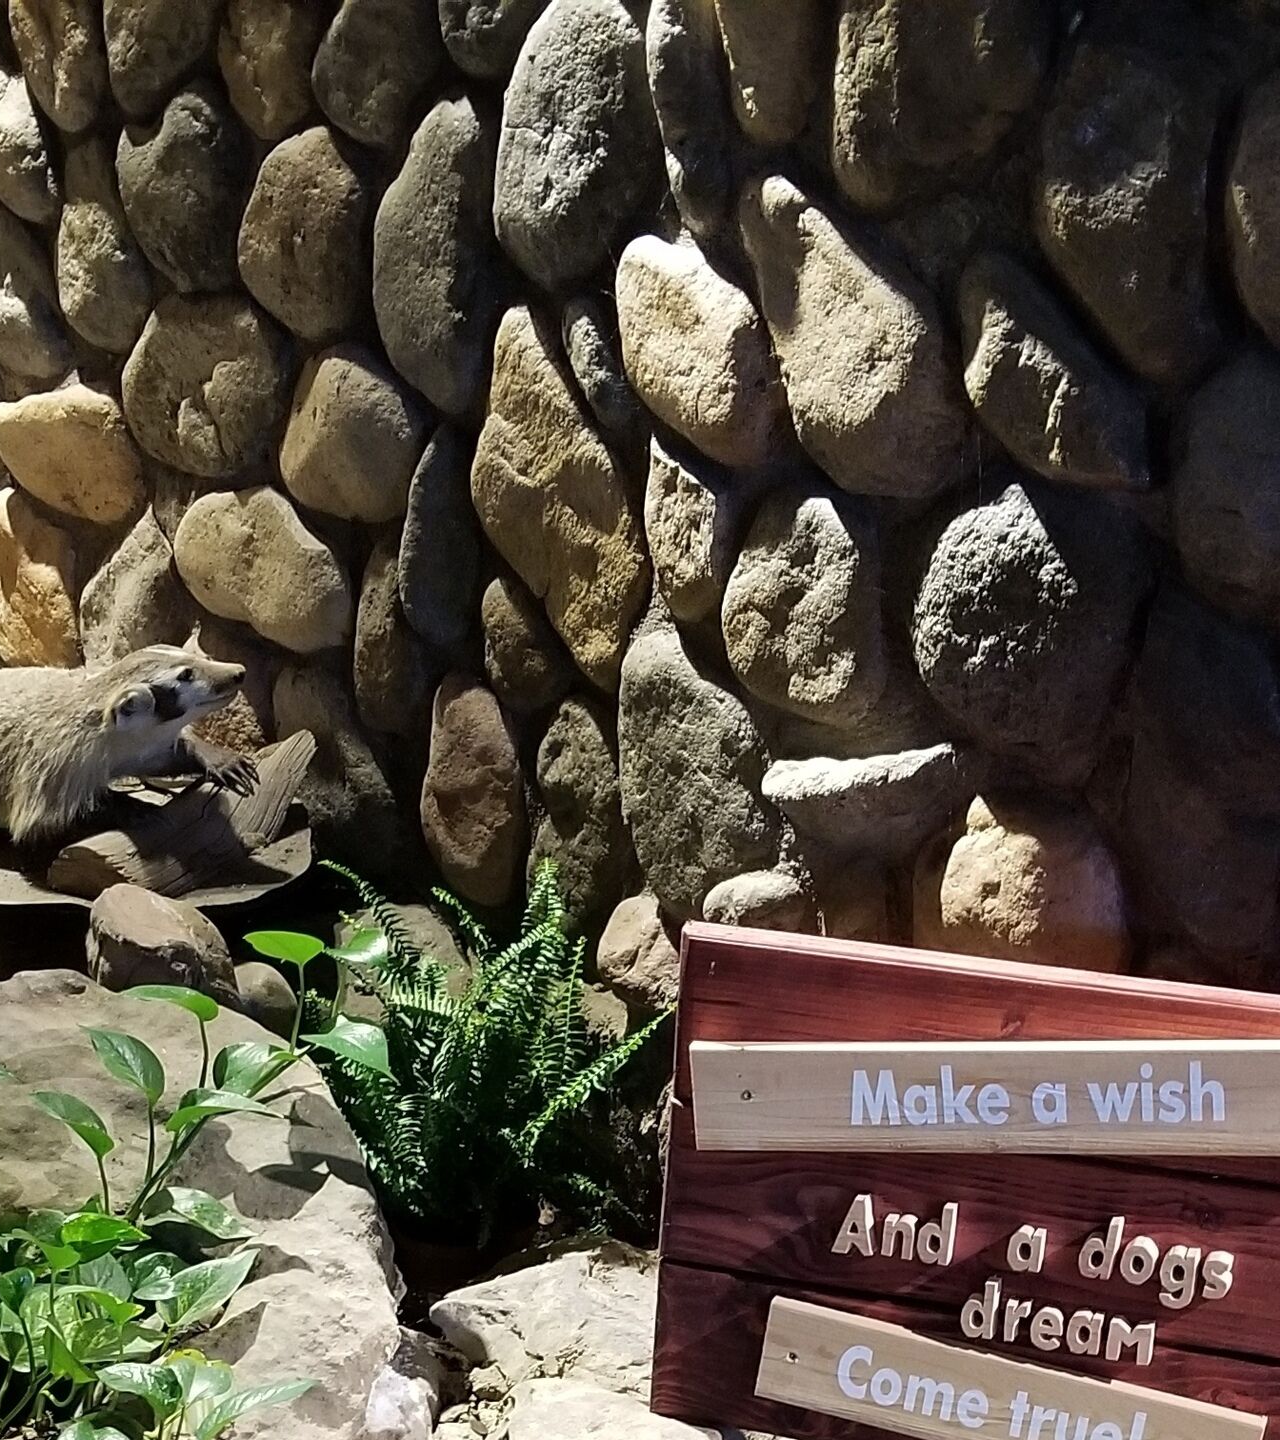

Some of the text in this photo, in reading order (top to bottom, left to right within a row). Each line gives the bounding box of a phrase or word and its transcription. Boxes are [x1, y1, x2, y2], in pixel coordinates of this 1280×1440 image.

[850, 1060, 1227, 1126] Make a wish
[831, 1193, 1236, 1310] And a dogs
[836, 1344, 991, 1431] Come
